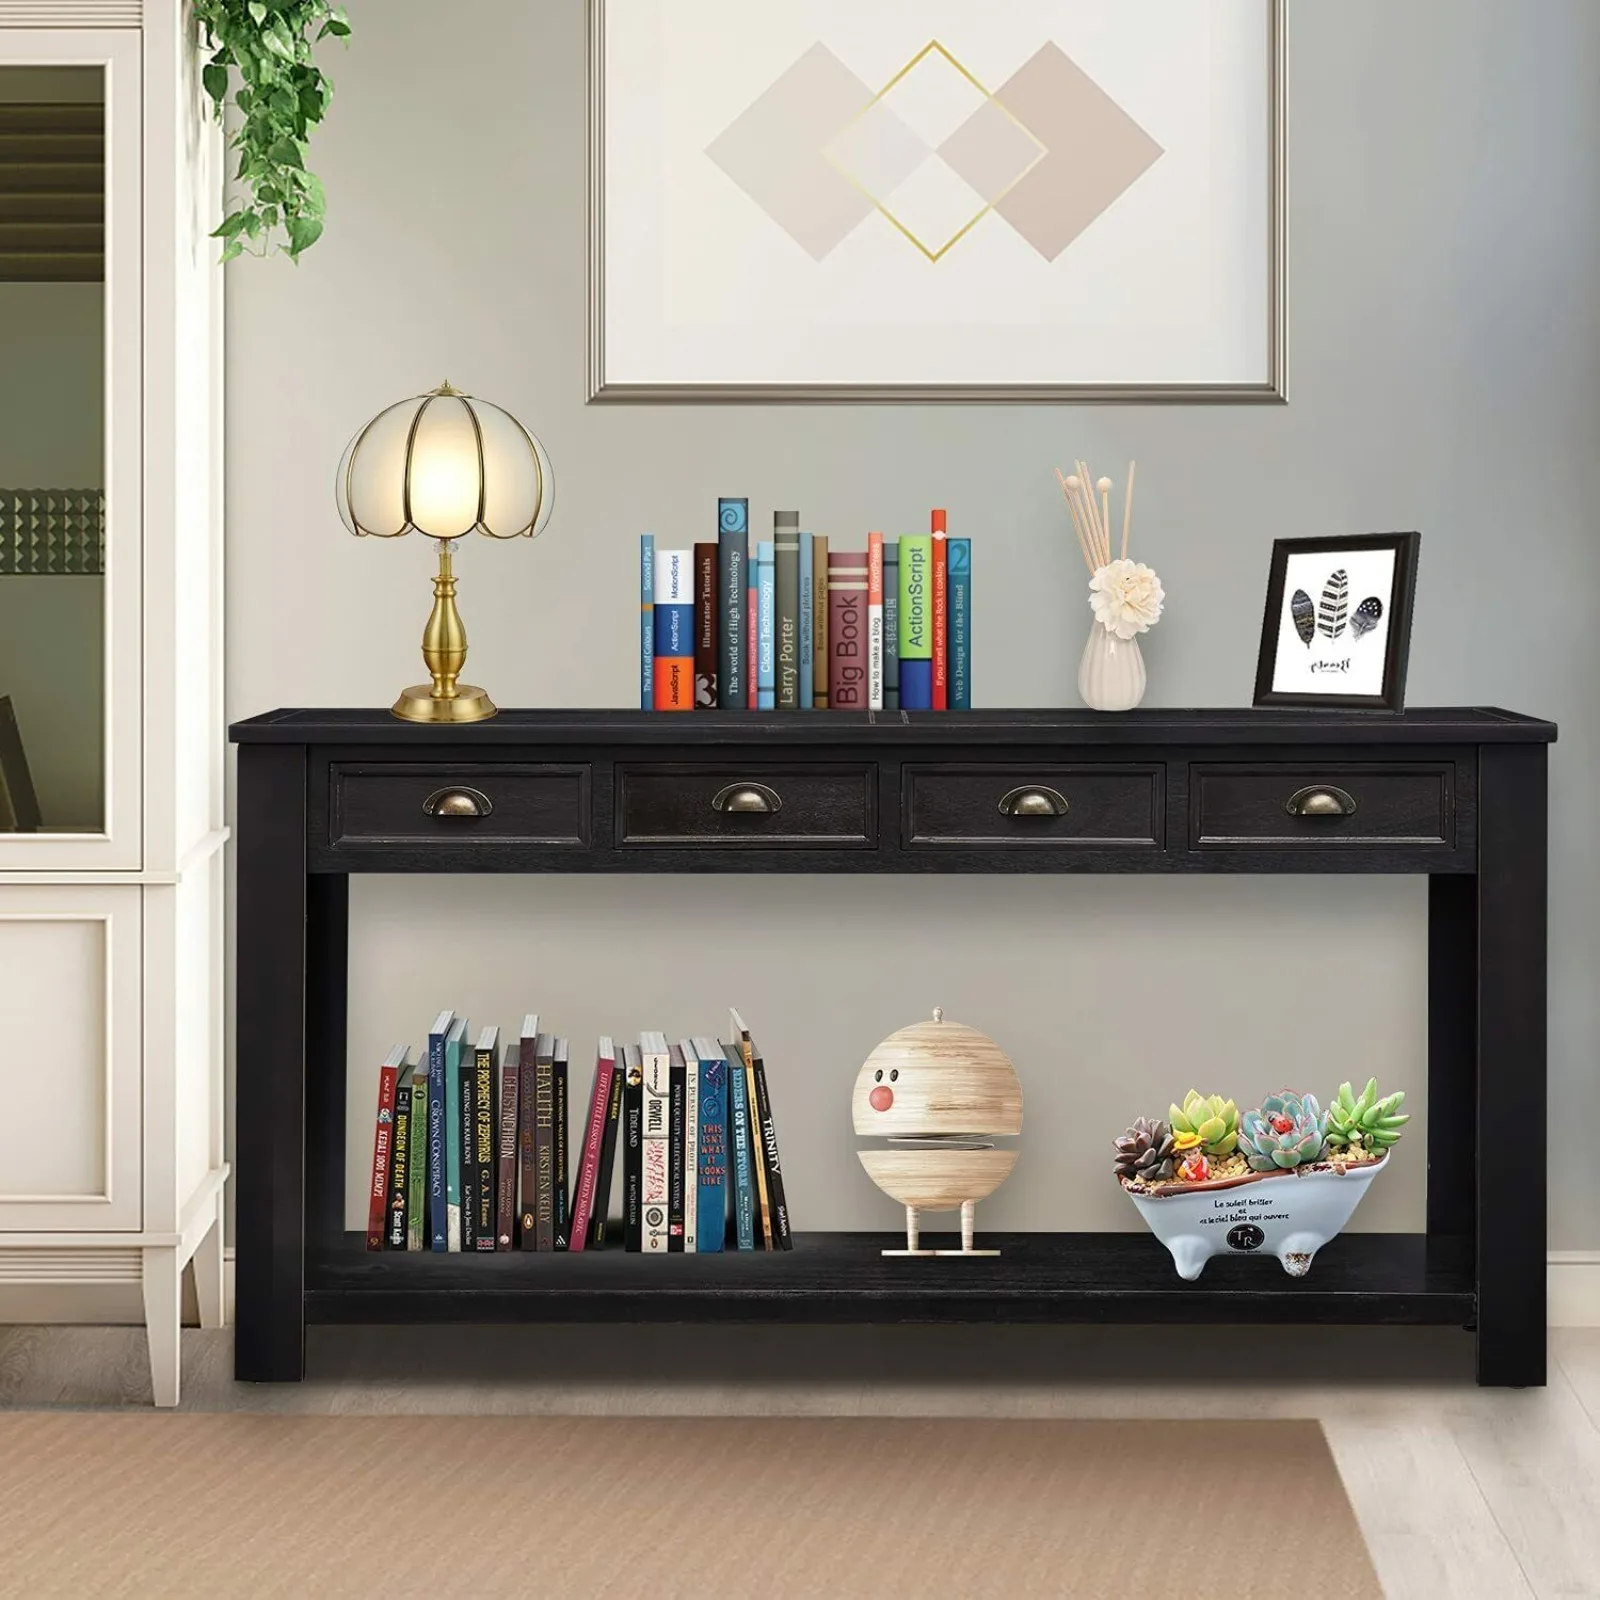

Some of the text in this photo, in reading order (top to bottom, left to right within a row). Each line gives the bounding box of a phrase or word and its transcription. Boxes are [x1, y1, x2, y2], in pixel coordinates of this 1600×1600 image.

[643, 546, 651, 591] Second Part
[872, 543, 880, 592] WordPress
[951, 542, 968, 573] 2
[671, 555, 680, 599] MotionScript
[936, 562, 944, 590] cooking
[702, 558, 711, 648] Illustrator Tutorials
[908, 548, 925, 647] ActionScript
[671, 610, 680, 651] ActionScript
[728, 550, 740, 695] The world of High Technology
[761, 581, 773, 673] Cloud Technology
[802, 577, 811, 665] Book without pictures
[872, 617, 881, 635] blog
[885, 598, 897, 656] 本书在中国
[643, 626, 651, 692] The Art of Colours
[780, 617, 797, 703] Larry Porter
[836, 596, 864, 704] Big Book
[872, 646, 880, 668] make
[955, 584, 965, 700] Web Design for the Blind
[671, 665, 680, 705] JavaScript
[872, 671, 880, 679] to
[872, 682, 880, 700] How
[537, 1064, 553, 1128] HALITH
[558, 1077, 563, 1085] ON
[674, 1084, 682, 1106] POWER
[688, 1073, 697, 1083] IN
[732, 1069, 744, 1109] RIDERS
[464, 1080, 472, 1164] WAITING FOR KARL ROVE
[477, 1053, 491, 1163] THE PROPHECY OF ZEPHYRUS
[501, 1075, 517, 1159] GEOSYNCHRON
[594, 1094, 606, 1120] LITTLE
[611, 1102, 619, 1120] BACK
[648, 1099, 662, 1132] ORWELL
[674, 1107, 682, 1135] QUALITY
[688, 1086, 697, 1124] PURSUIT
[735, 1111, 745, 1126] ON
[377, 1130, 387, 1152] KEDAI
[589, 1119, 602, 1150] LESSONS
[629, 1108, 640, 1147] TIDELAND
[688, 1126, 697, 1137] OF
[703, 1124, 722, 1133] THIS
[736, 1128, 746, 1149] THE
[375, 1154, 386, 1171] 1001
[394, 1115, 407, 1188] DUNGEON OF DEATH
[431, 1099, 441, 1197] CROWN CONSPIRACY
[524, 1144, 531, 1152] to
[674, 1142, 682, 1180] ELECTRICAL
[688, 1141, 697, 1172] PROFIT
[701, 1146, 725, 1154] WHAT
[708, 1156, 715, 1164] IT
[763, 1117, 781, 1175] TRINITY
[540, 1144, 550, 1223] KIRSTEN KELLY
[700, 1167, 725, 1175] LOOKS
[702, 1177, 721, 1185] LIKE
[737, 1151, 748, 1187] STORM
[481, 1169, 490, 1227] G. A. Hesse
[575, 1163, 594, 1234] KATHRYN MORAVEC
[1214, 1200, 1224, 1208] Le
[1226, 1199, 1247, 1207] soleil
[393, 1211, 403, 1227] Scott
[1248, 1213, 1262, 1222] qui
